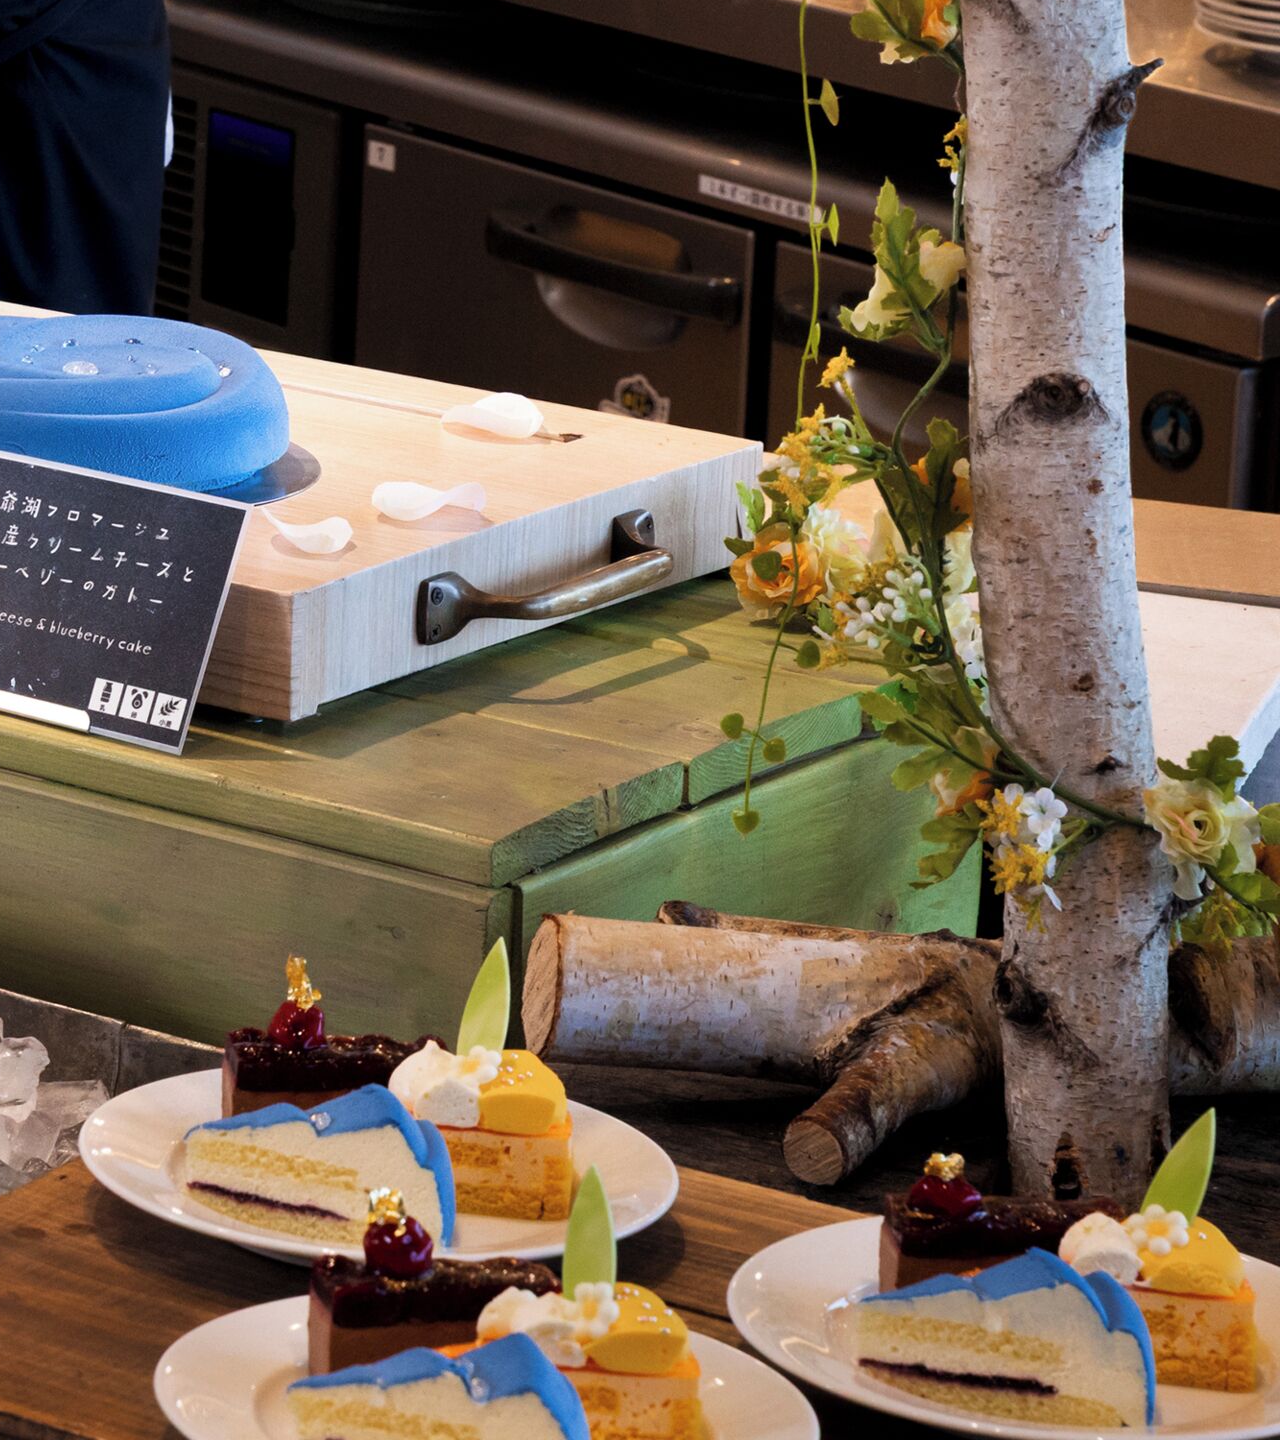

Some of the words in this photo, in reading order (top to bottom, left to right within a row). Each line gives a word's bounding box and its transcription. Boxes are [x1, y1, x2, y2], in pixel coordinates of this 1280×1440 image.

[35, 617, 46, 631] &
[49, 620, 115, 650] blueberry
[117, 638, 153, 656] cake
